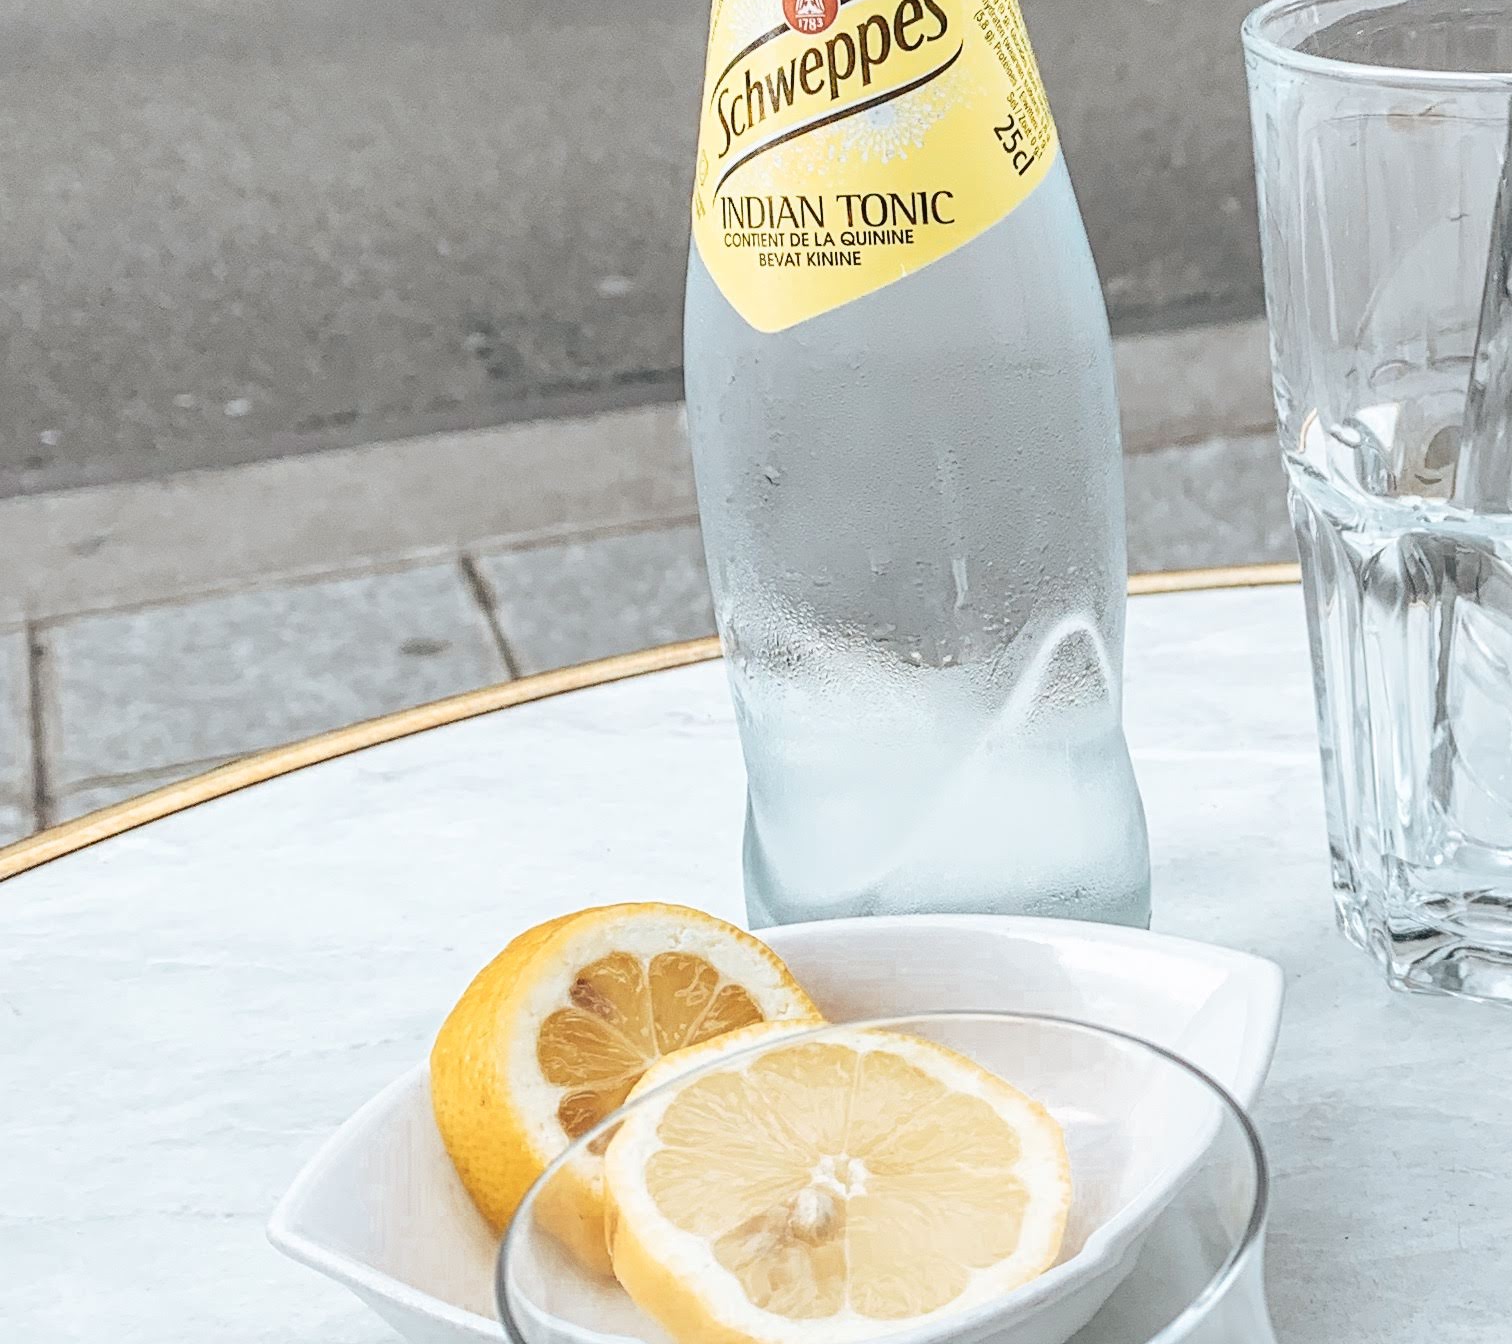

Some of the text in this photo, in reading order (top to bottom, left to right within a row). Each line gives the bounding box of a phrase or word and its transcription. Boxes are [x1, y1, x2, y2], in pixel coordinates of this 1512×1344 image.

[797, 17, 824, 31] 1783
[993, 113, 1035, 176] 25cl
[720, 190, 956, 229] INDIAN TONIC
[724, 229, 914, 247] CONTIENT DE LA QUININE
[759, 251, 862, 267] BEVAT KININE
